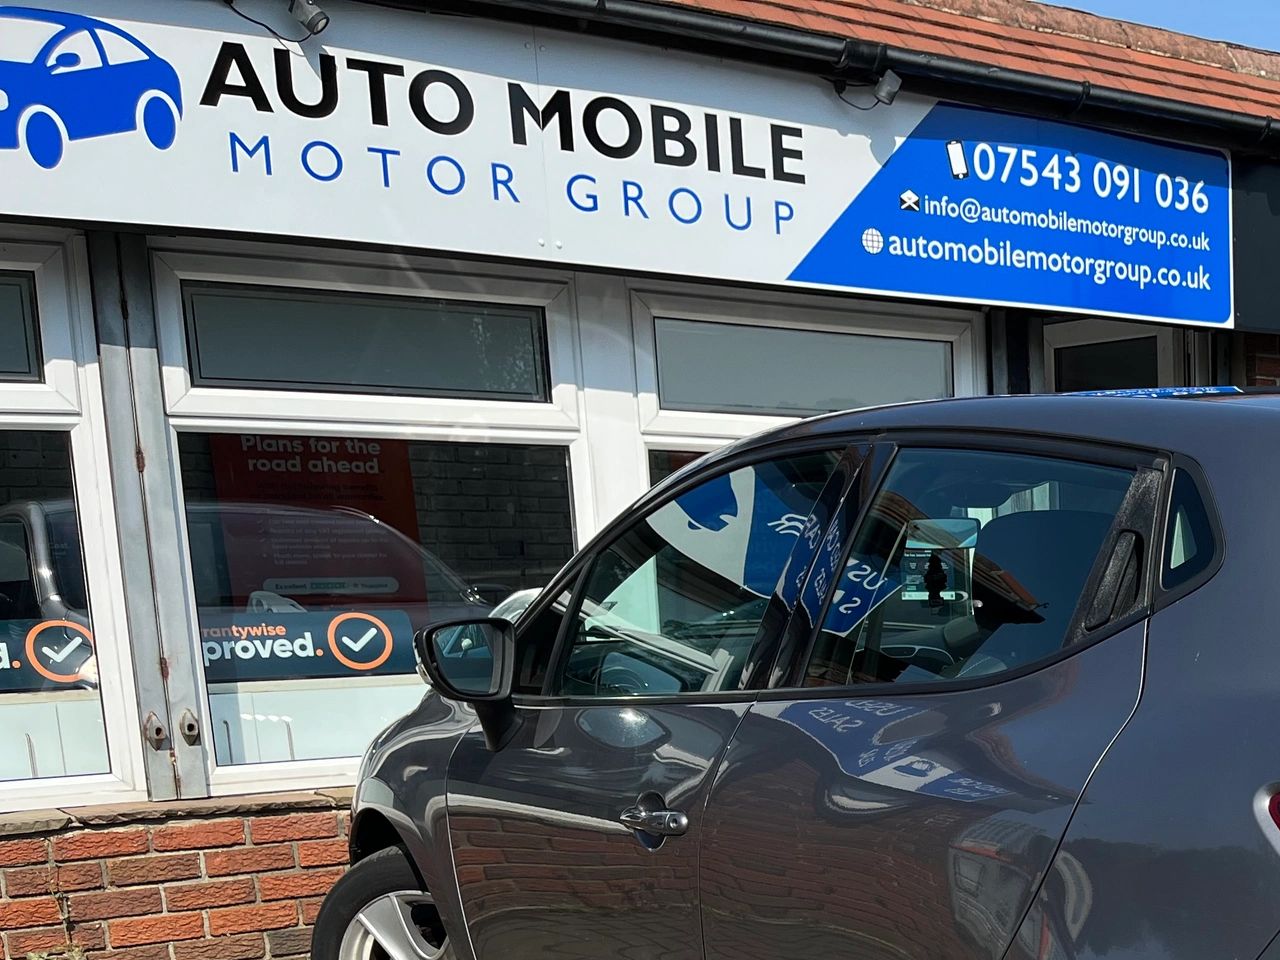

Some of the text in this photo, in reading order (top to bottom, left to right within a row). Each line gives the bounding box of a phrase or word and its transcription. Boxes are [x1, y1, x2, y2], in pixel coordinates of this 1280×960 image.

[200, 42, 806, 185] AUTO MOBILE
[229, 132, 795, 236] MOTOR GROUP
[973, 142, 1209, 214] 07543 091 036
[924, 194, 1211, 252] info@automobilemotorgroup.co.uk
[888, 232, 1211, 291] automobilemotorgroup.co.uk
[240, 434, 381, 455] Plans for the
[248, 455, 380, 474] road ahead
